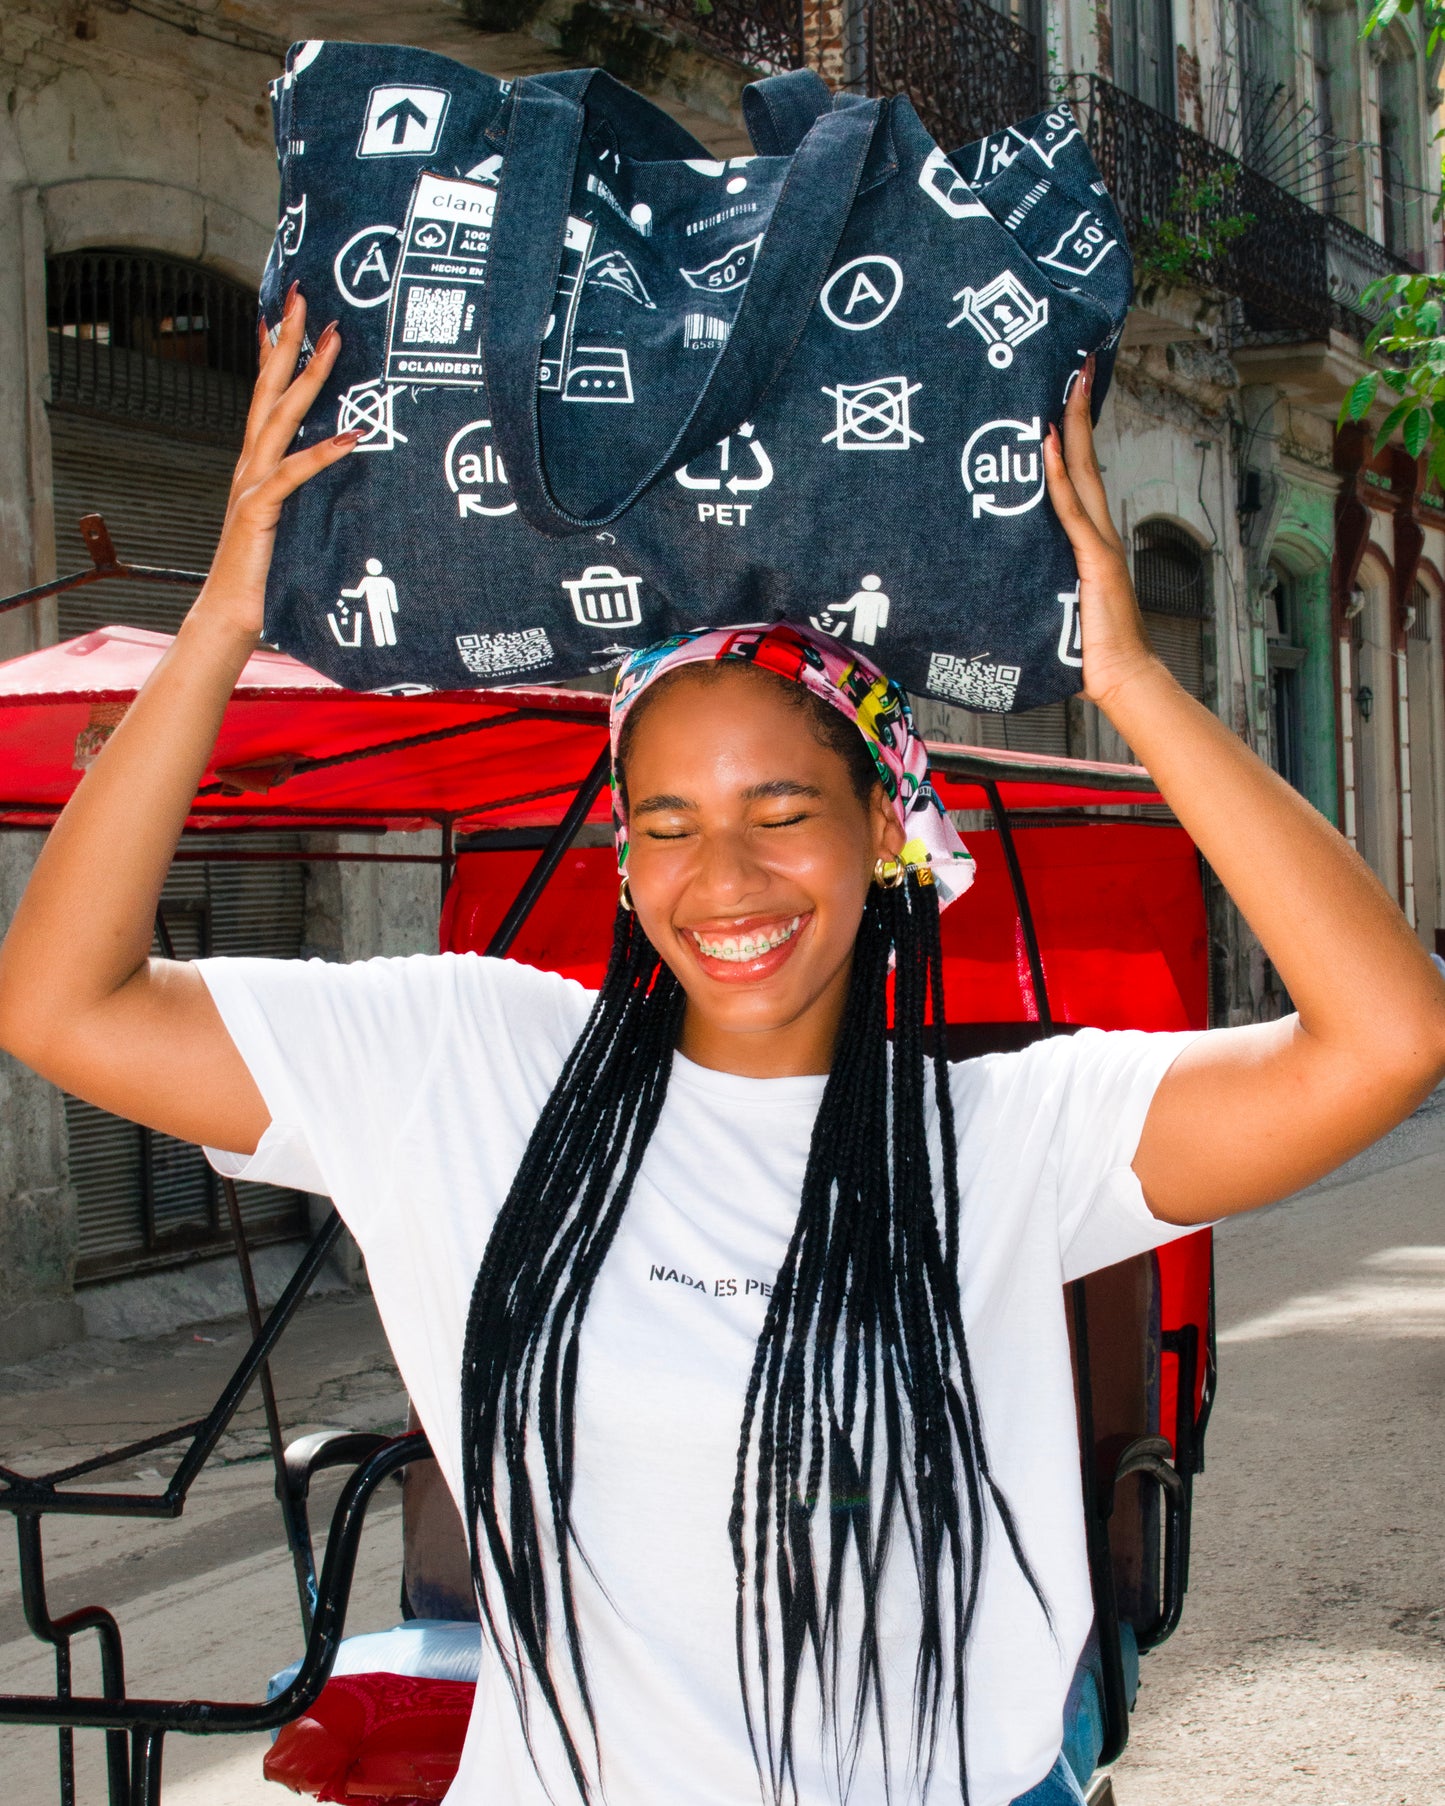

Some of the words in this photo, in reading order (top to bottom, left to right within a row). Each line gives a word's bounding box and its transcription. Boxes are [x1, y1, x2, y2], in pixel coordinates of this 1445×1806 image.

[460, 240, 489, 252] ALG
[431, 264, 467, 275] HECHO
[469, 266, 484, 276] EN
[843, 272, 885, 316] A
[463, 304, 476, 331] INFO
[398, 360, 483, 375] @CLANDESTI
[974, 445, 1038, 484] alu
[697, 503, 752, 527] PET
[650, 1264, 707, 1294] NADA
[714, 1278, 738, 1297] ES
[744, 1278, 774, 1298] PE
